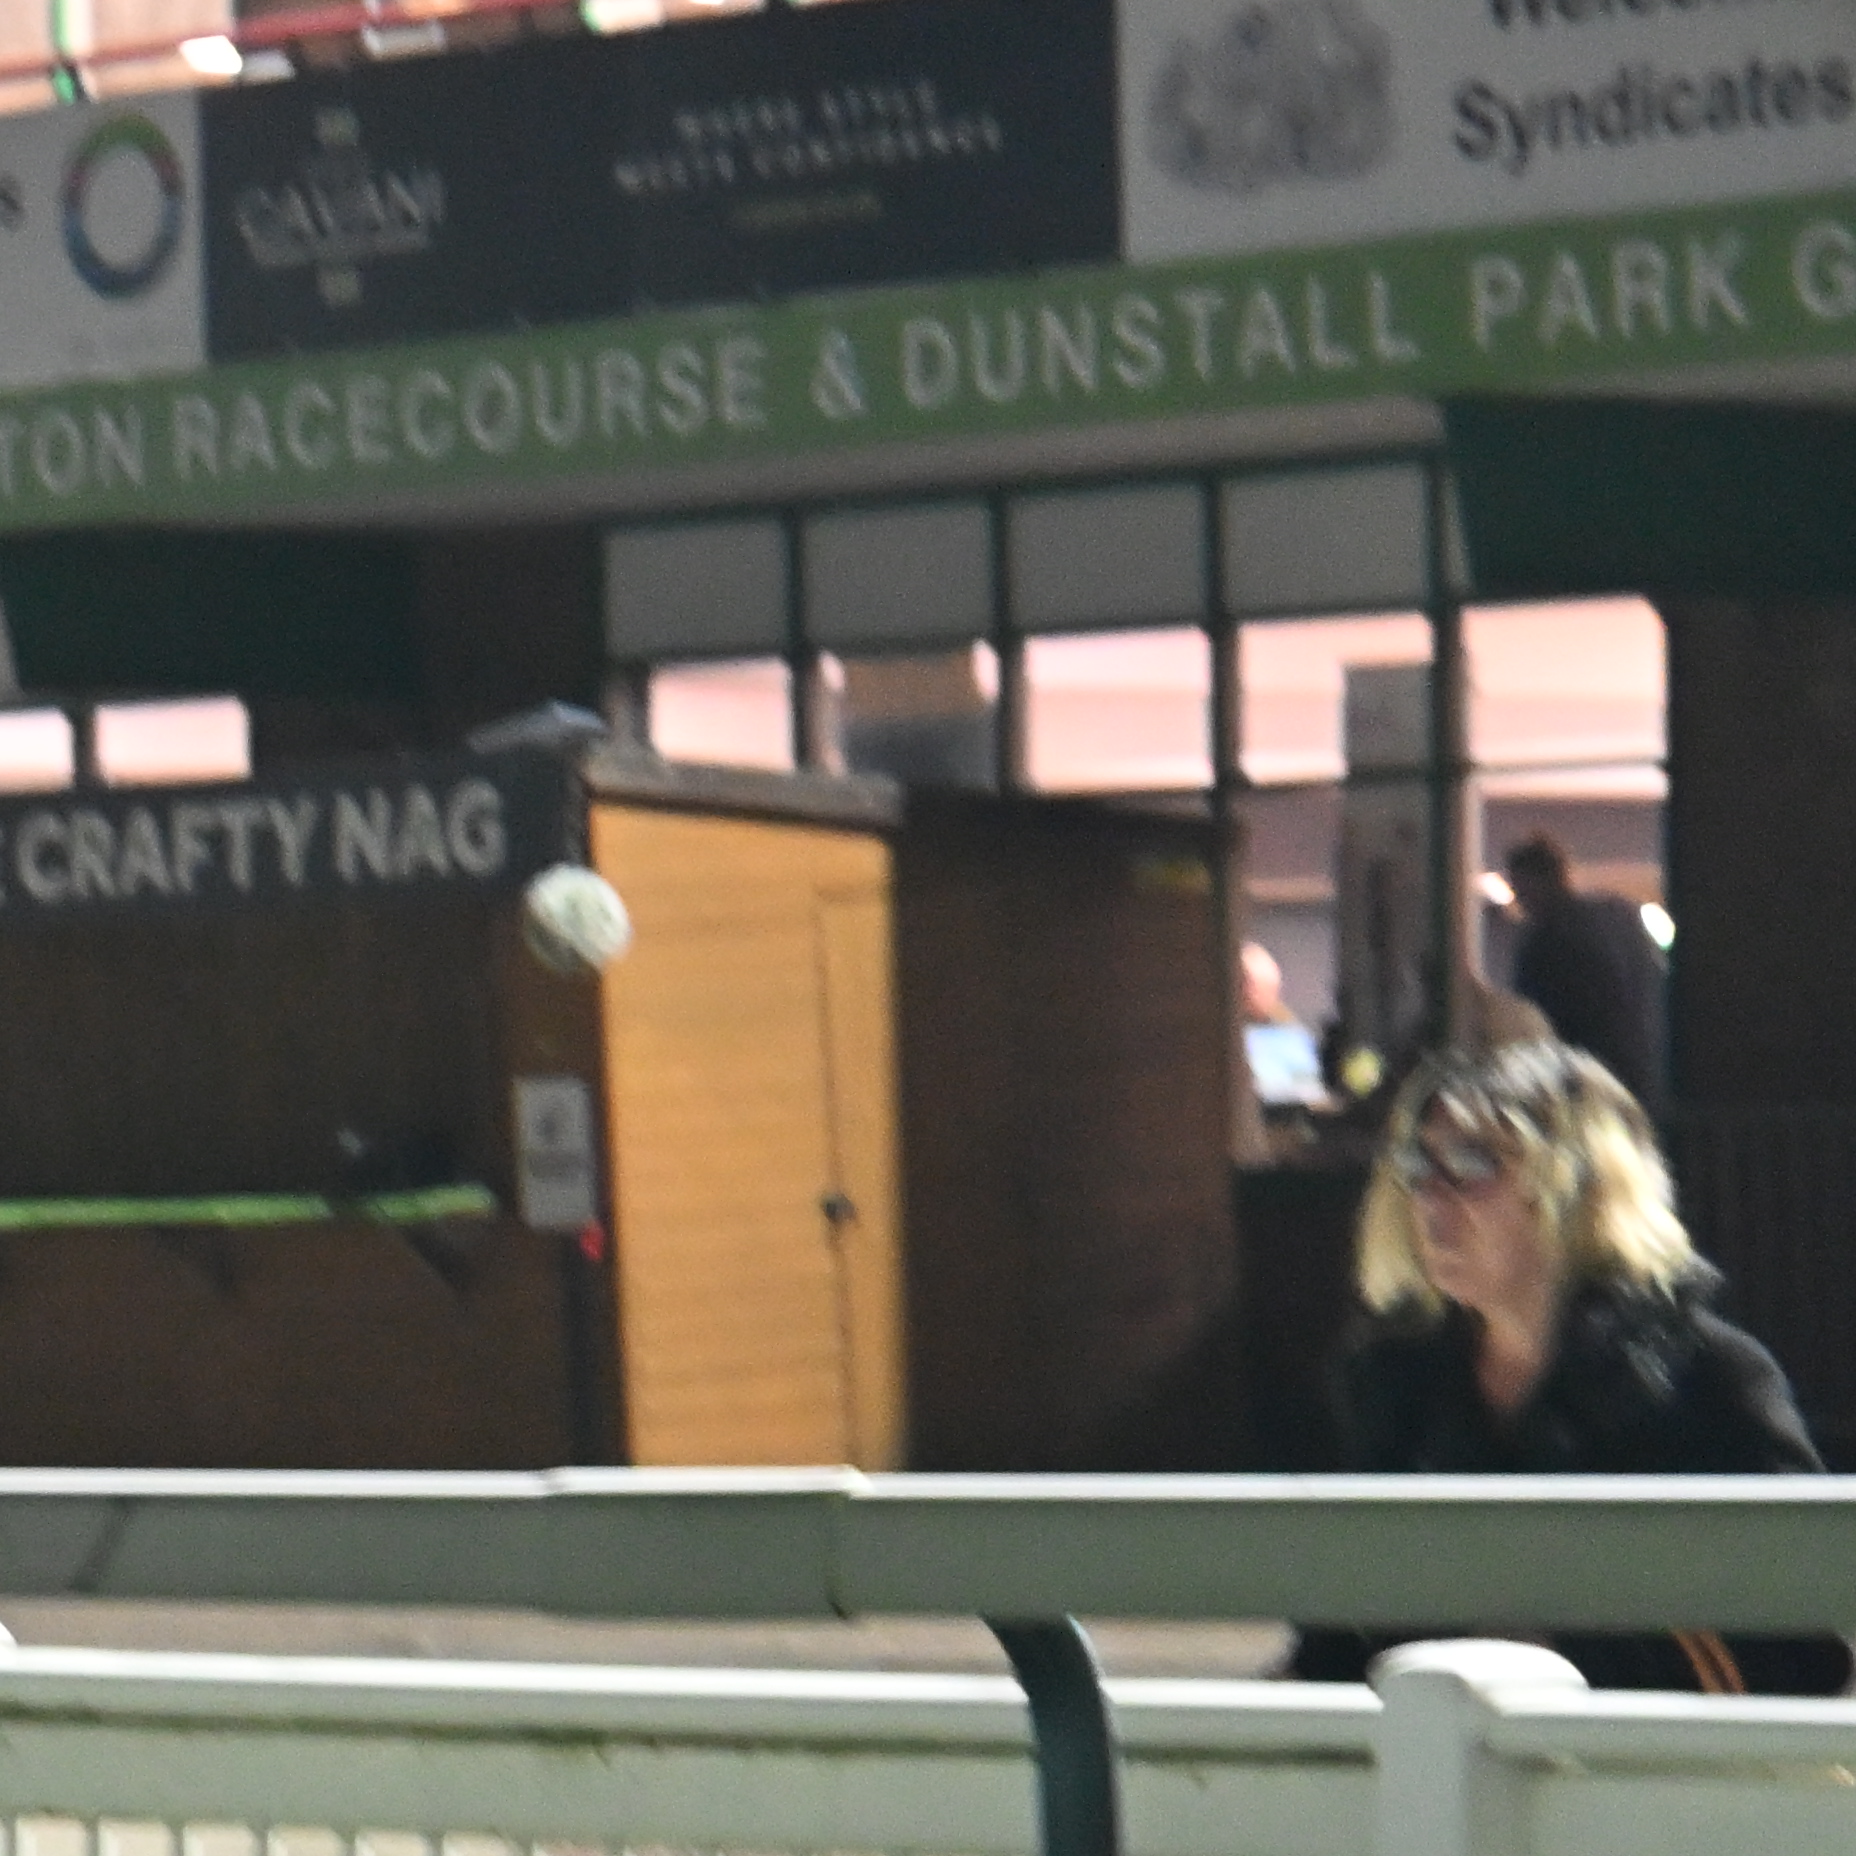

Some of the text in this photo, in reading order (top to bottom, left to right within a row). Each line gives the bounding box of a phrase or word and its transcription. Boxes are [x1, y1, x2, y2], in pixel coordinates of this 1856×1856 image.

[1452, 55, 1854, 176] Syndicates
[171, 334, 770, 485] RACECOURSE
[811, 327, 868, 422] &
[900, 271, 1420, 414] DUNSTALL
[1469, 232, 1751, 352] PARK
[15, 790, 315, 900] CRAFTY
[331, 779, 506, 884] NAG
